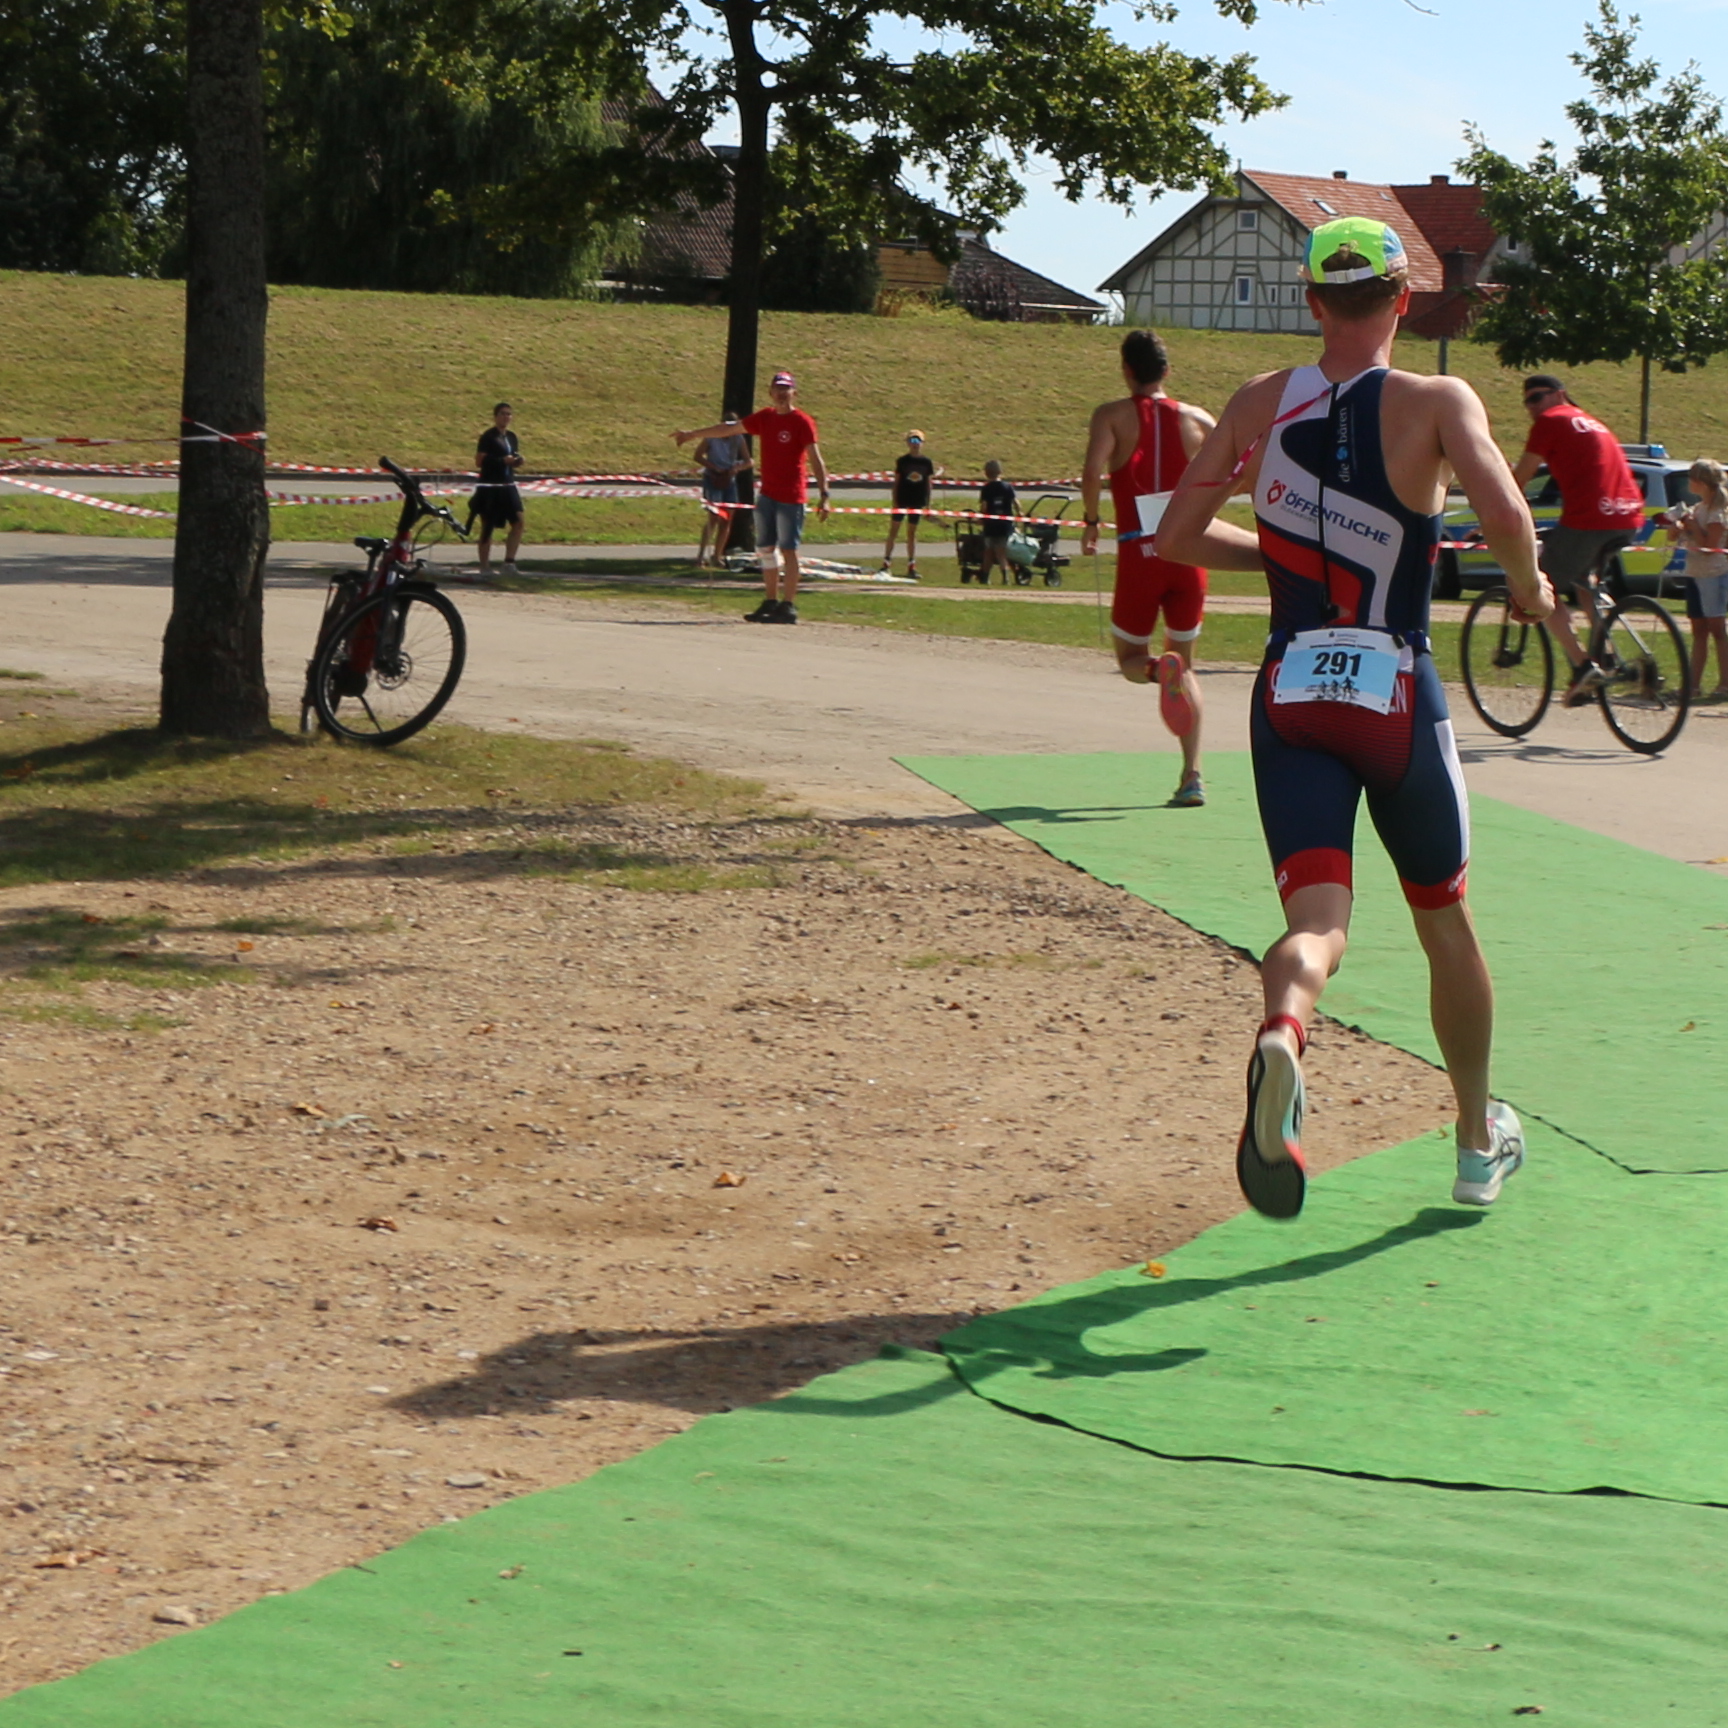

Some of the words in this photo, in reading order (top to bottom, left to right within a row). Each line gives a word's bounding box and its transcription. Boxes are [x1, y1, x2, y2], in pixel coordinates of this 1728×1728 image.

[1337, 407, 1348, 443] bären
[1338, 463, 1351, 483] die
[1284, 490, 1391, 547] ÖFFENTLICHE
[1312, 651, 1362, 677] 291
